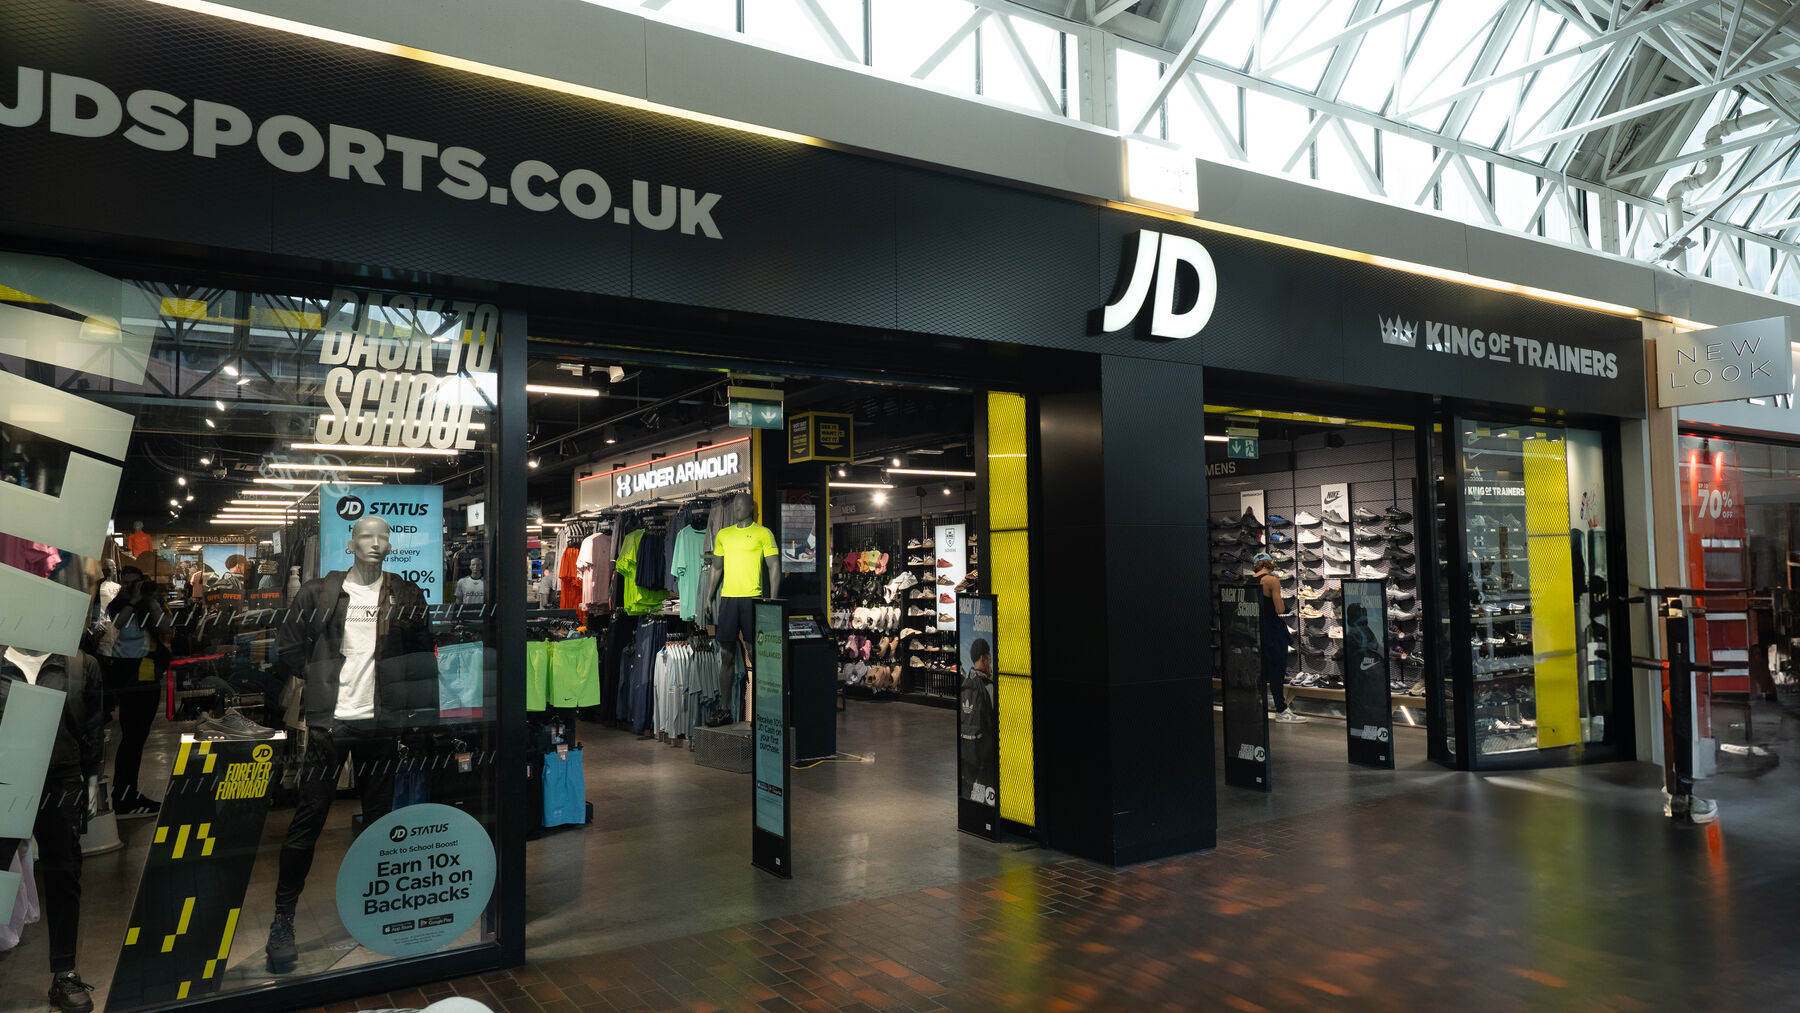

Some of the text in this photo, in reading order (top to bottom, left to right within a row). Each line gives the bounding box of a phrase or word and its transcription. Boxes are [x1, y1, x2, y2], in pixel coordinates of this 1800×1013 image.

[0, 66, 723, 240] JDSPORTS.CO.UK
[1103, 229, 1217, 338] JD
[319, 287, 499, 374] BACK TO
[1425, 320, 1618, 379] KING OF TRAINERS
[1677, 336, 1762, 365] NEW
[1671, 359, 1773, 389] LOOK
[315, 367, 477, 450] SCHOOL
[633, 452, 739, 492] UNDER ARMOUR
[1492, 487, 1525, 496] TRAINERS
[339, 501, 429, 516] JD STATUS
[1698, 489, 1733, 519] 70%
[1722, 511, 1733, 519] OFF
[389, 525, 417, 534] NDED
[390, 555, 411, 563] shop!
[401, 570, 435, 583] 10%
[256, 748, 270, 758] JD
[225, 762, 272, 782] FOREVER
[215, 780, 269, 800] FORWARD
[392, 823, 449, 839] JD STATUS
[379, 840, 459, 857] Back to School Boost!
[377, 853, 461, 878] Earn 10x
[362, 869, 473, 898] JD Cash on
